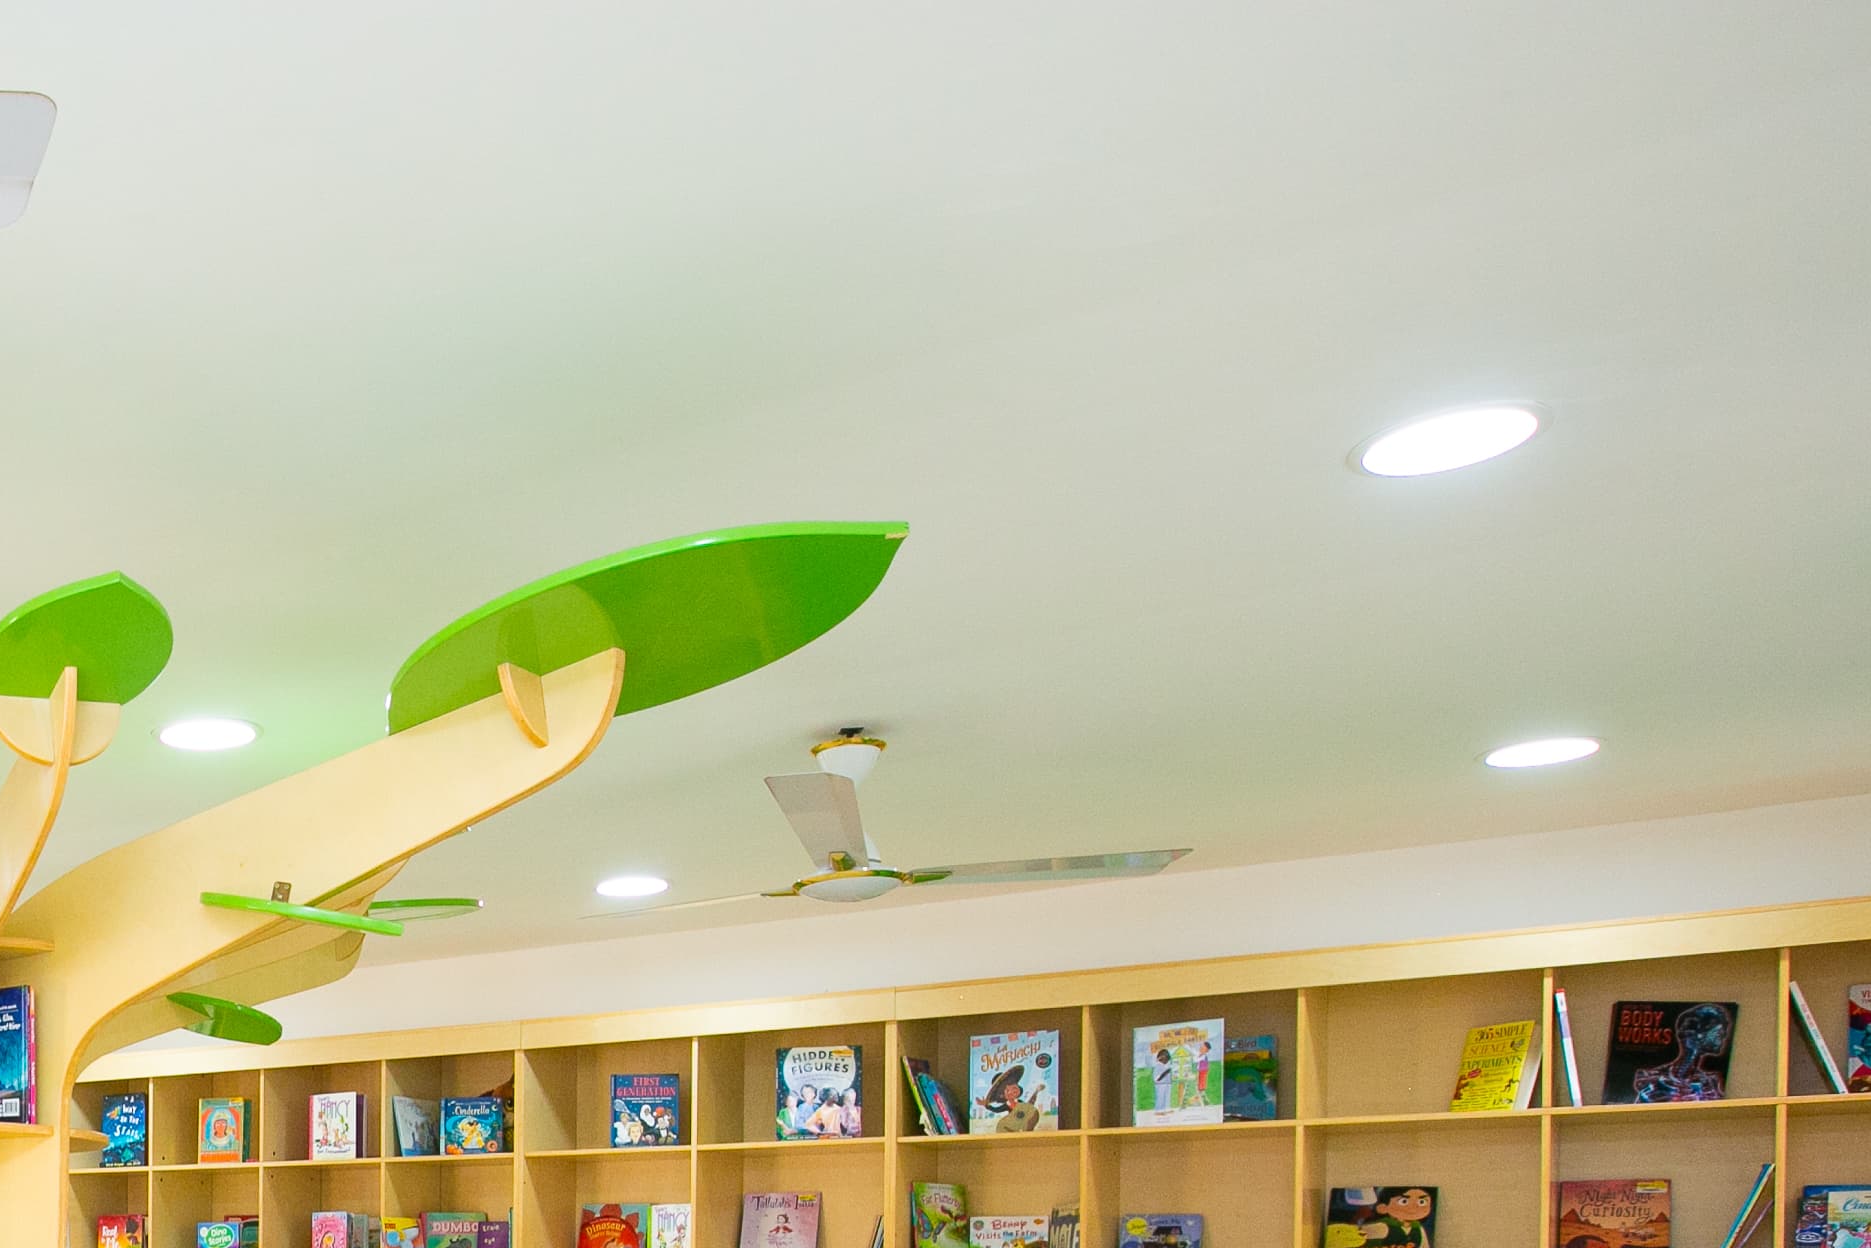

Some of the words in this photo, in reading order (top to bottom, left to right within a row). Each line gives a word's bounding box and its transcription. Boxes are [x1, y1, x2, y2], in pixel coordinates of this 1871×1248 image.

[1621, 1010, 1664, 1026] BODY
[1619, 1028, 1671, 1045] WORKS
[792, 1050, 845, 1064] HIDDE
[791, 1063, 850, 1075] FIGURES
[633, 1077, 660, 1086] FIRST
[616, 1087, 676, 1097] GENERATION
[455, 1105, 490, 1115] Cinderella
[1580, 1203, 1650, 1224] Curiosity
[432, 1222, 479, 1233] DUMBO
[586, 1222, 626, 1235] Dinosaur
